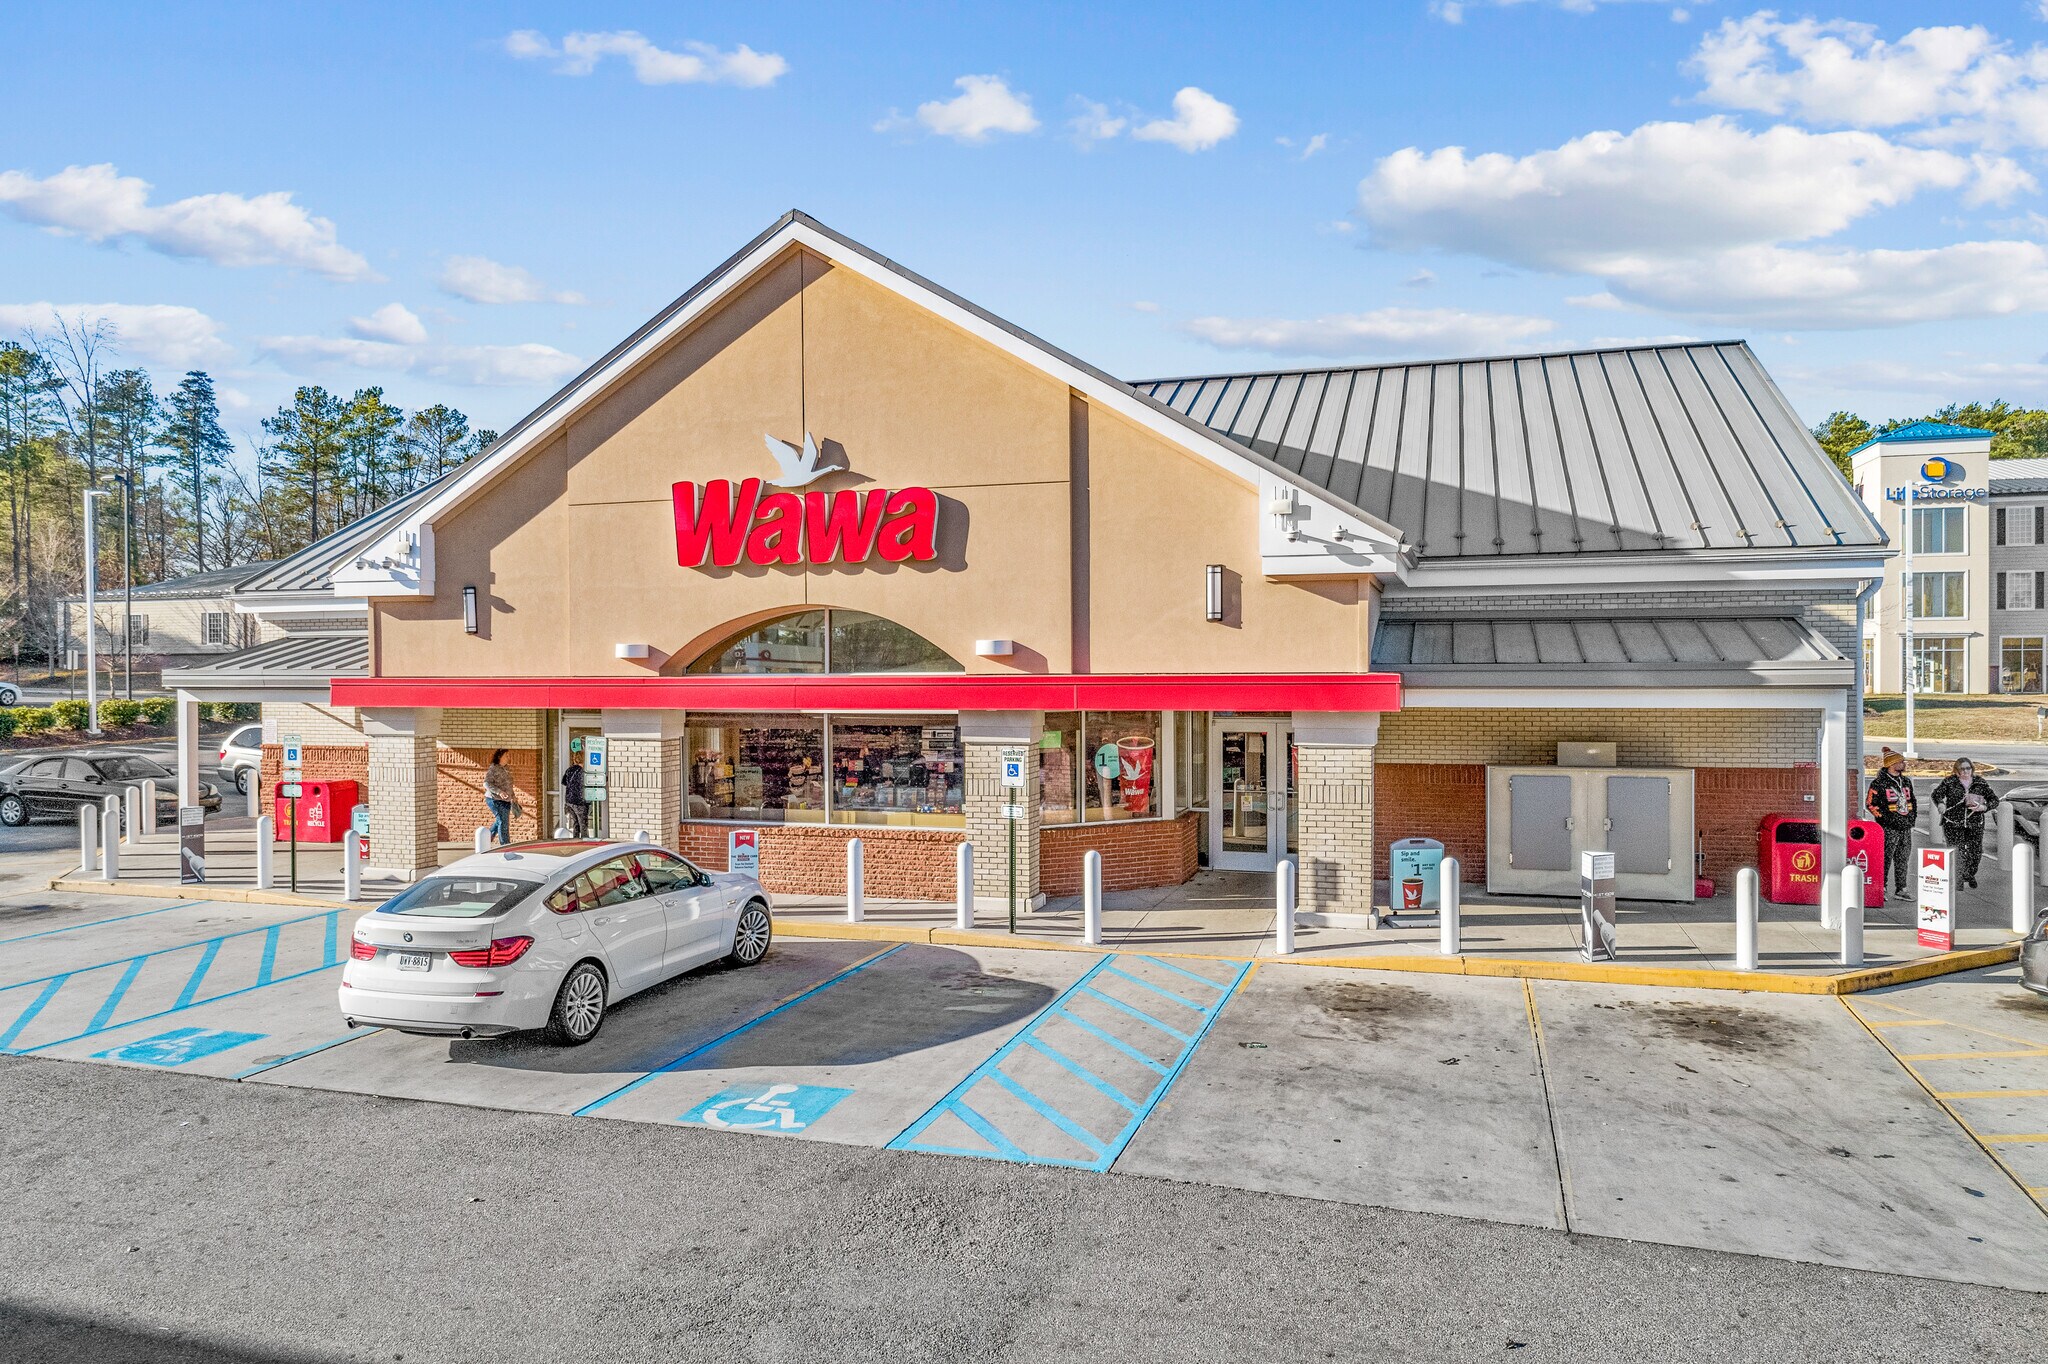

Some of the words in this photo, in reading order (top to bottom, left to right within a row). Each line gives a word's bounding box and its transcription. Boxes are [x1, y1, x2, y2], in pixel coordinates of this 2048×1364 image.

[672, 478, 937, 567] Wawa
[1124, 787, 1145, 796] Wawa
[307, 819, 325, 827] RECYCLE
[1790, 873, 1819, 883] TRASH
